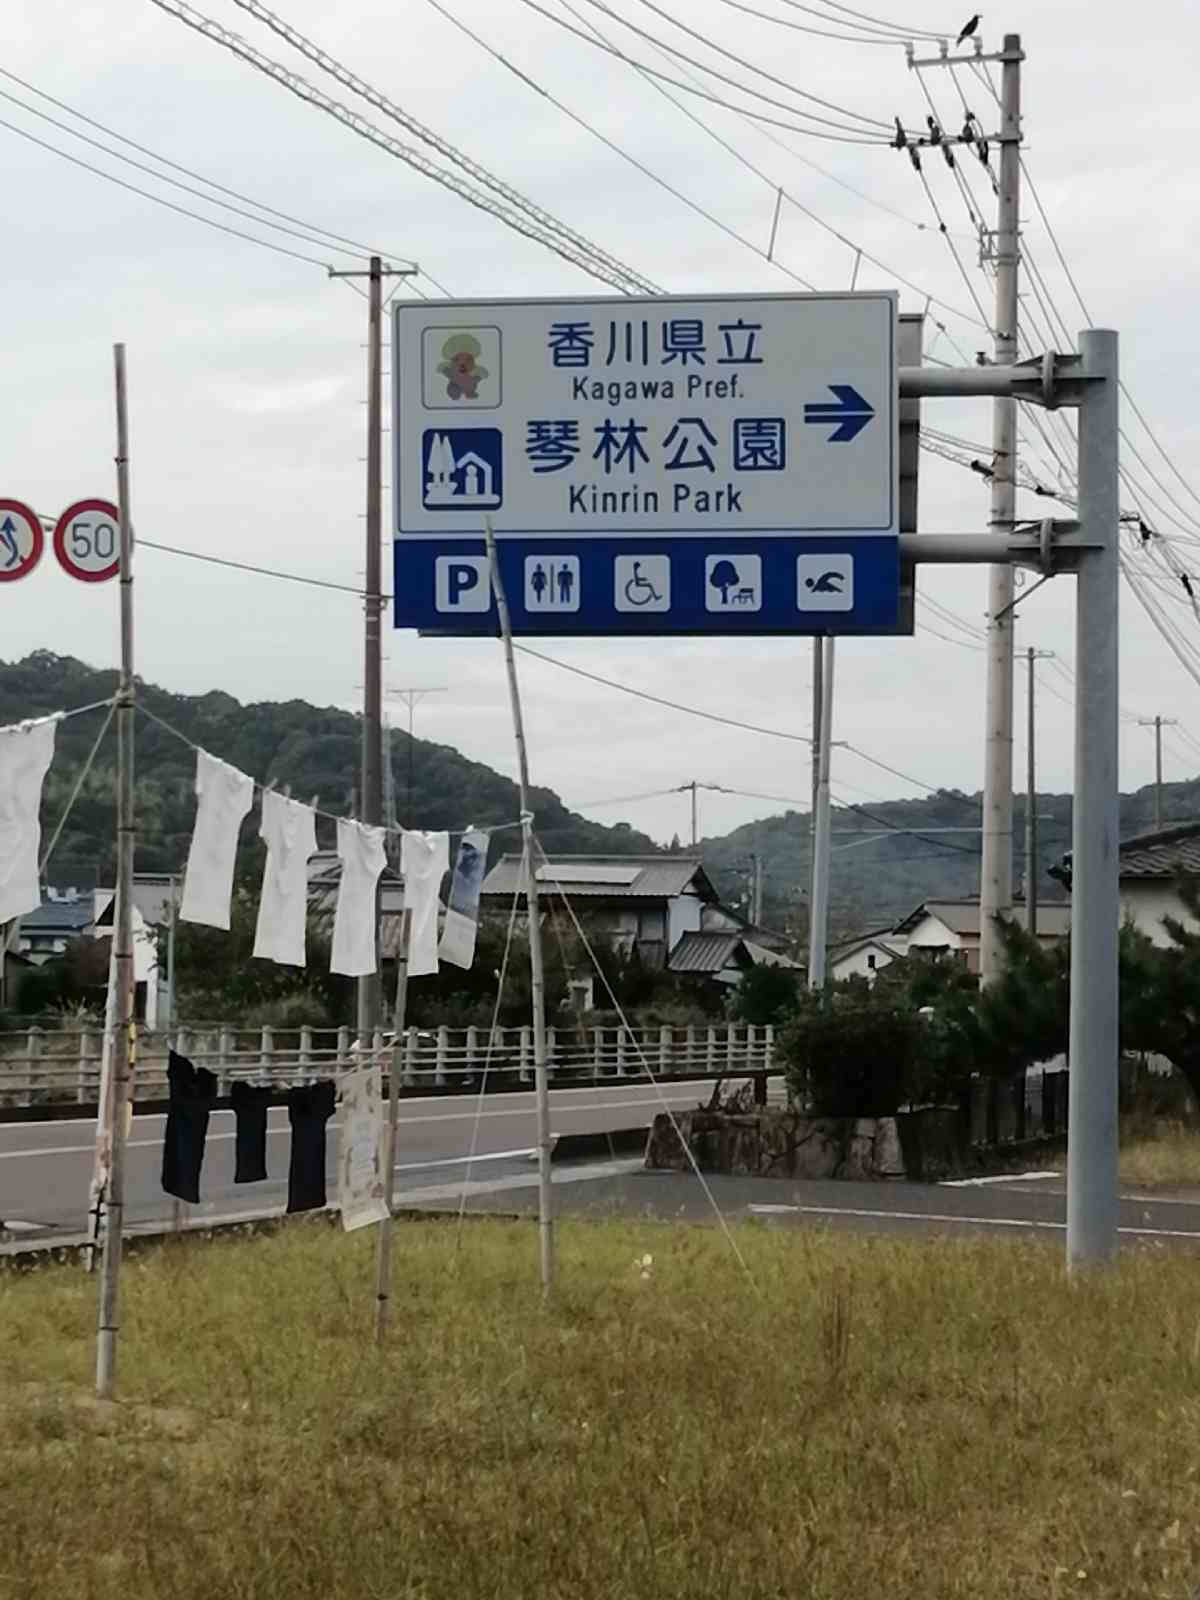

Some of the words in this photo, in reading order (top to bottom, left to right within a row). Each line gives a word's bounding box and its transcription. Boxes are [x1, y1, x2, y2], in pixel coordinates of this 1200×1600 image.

[548, 319, 764, 367] 香川県立
[572, 375, 674, 406] Kagawa
[687, 373, 744, 399] Pref.
[524, 417, 786, 474] 琴林公園
[568, 484, 659, 513] Kinrin
[673, 482, 743, 512] Park
[72, 523, 114, 558] 50
[448, 564, 478, 605] P
